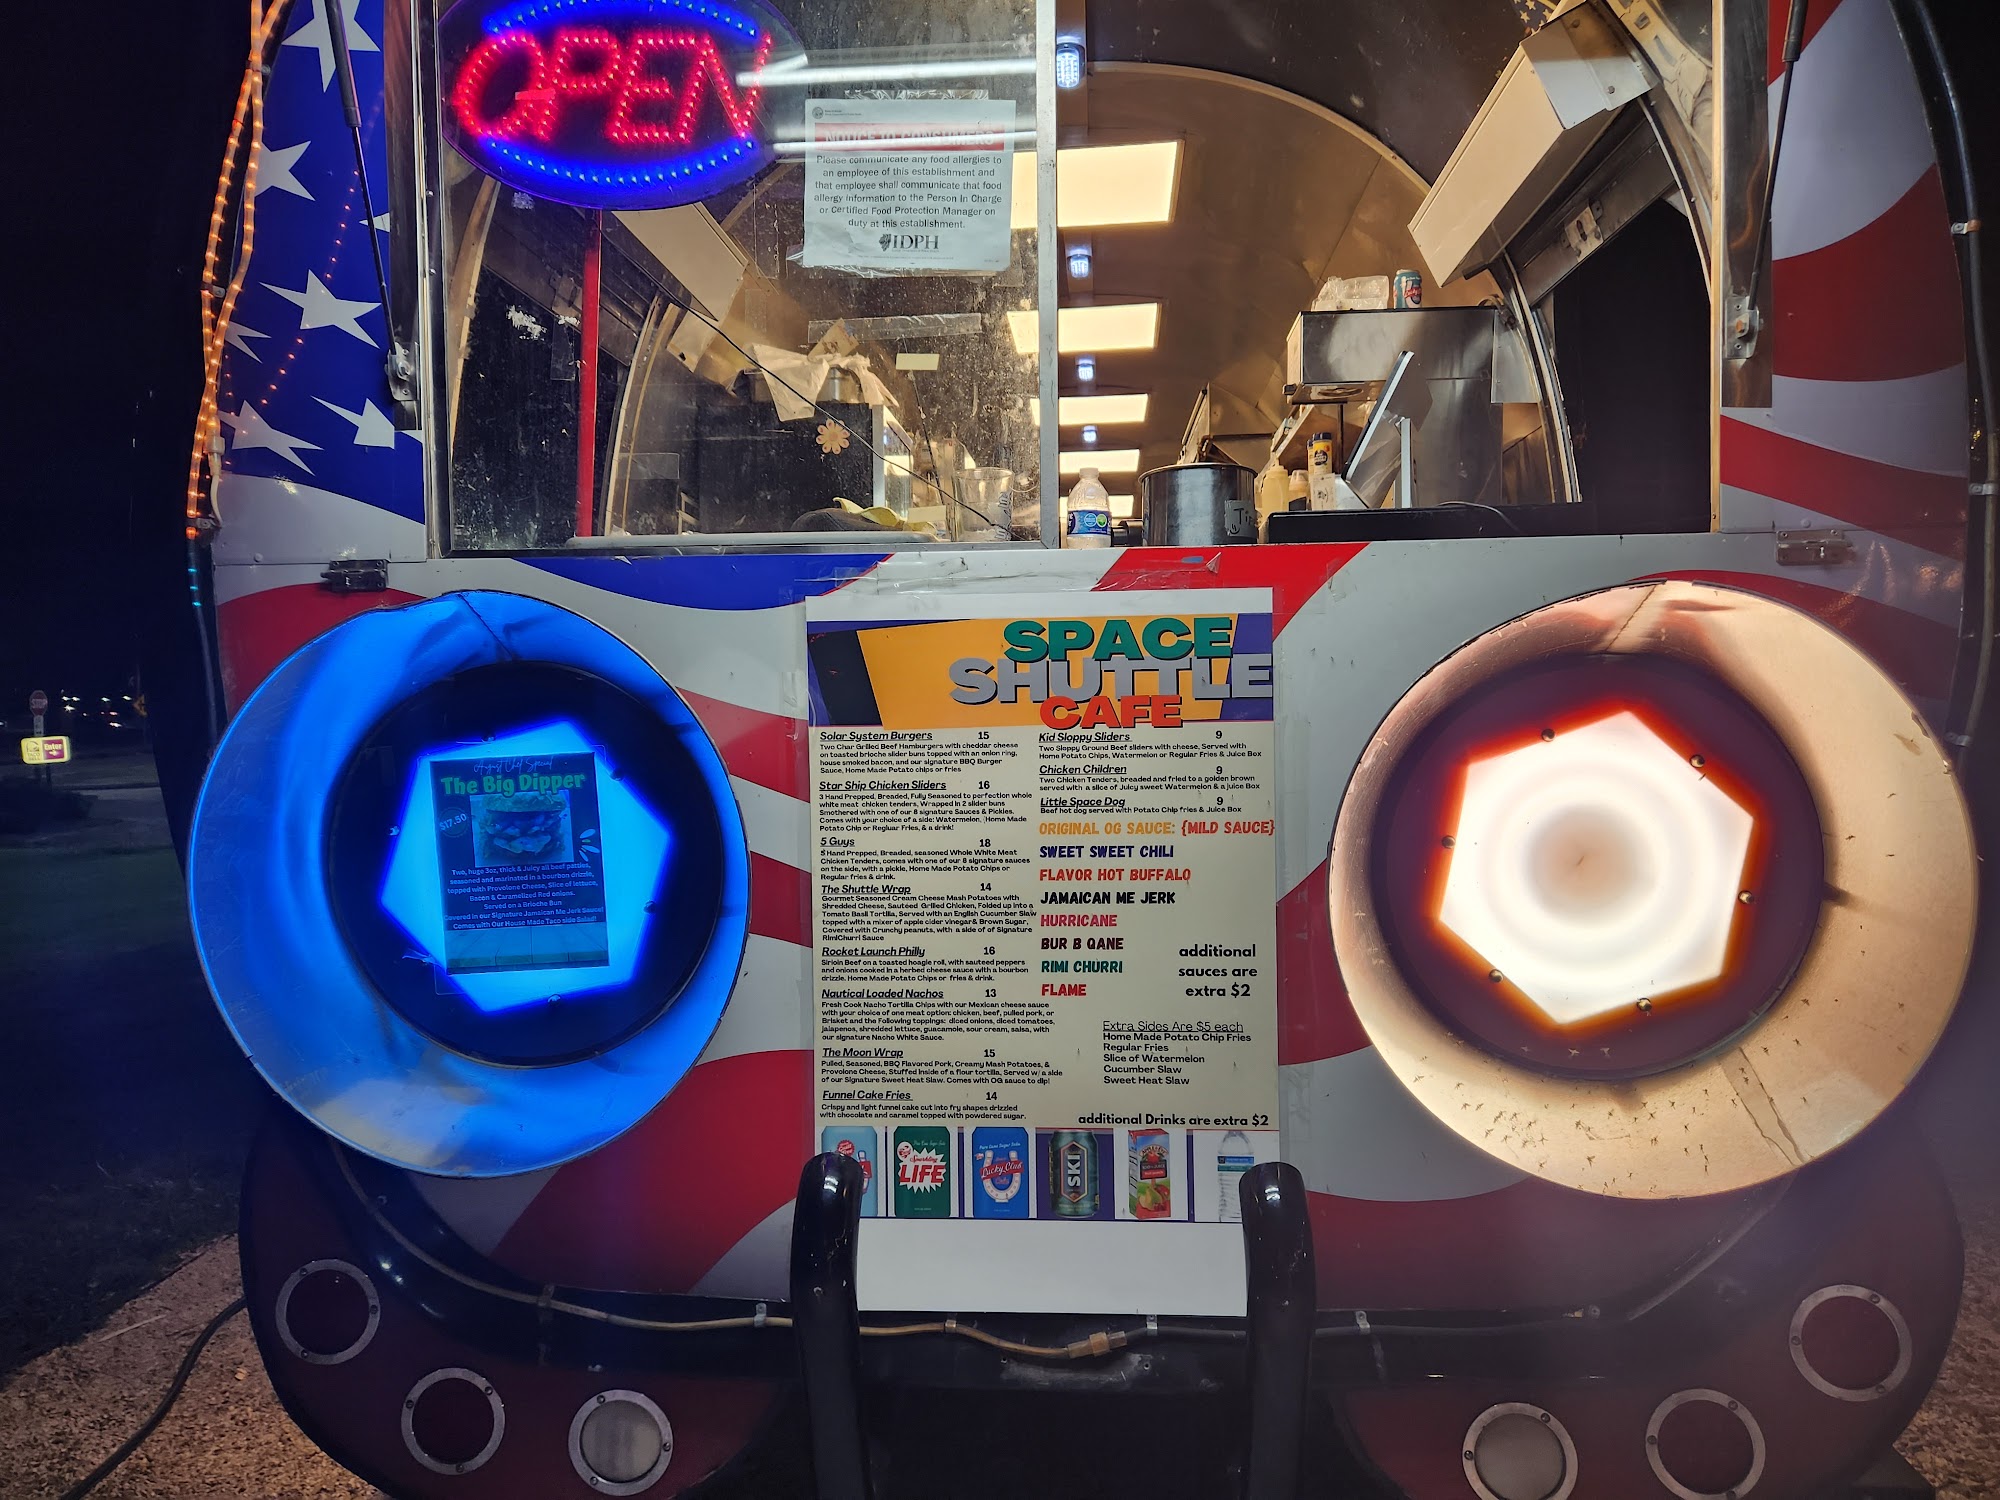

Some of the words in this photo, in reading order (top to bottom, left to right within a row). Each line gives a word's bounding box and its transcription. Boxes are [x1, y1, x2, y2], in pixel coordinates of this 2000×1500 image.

[455, 28, 774, 144] OPEN
[816, 155, 846, 164] Please
[912, 156, 927, 164] any
[953, 156, 990, 165] allergies
[837, 168, 878, 178] employee
[882, 168, 890, 176] of
[912, 168, 975, 176] establishment
[815, 181, 832, 189] that
[835, 182, 876, 191] employee
[901, 181, 960, 189] communicate
[963, 181, 980, 189] that
[814, 194, 843, 203] allergy
[927, 194, 956, 202] Person
[971, 195, 1002, 203] Charge
[832, 206, 868, 214] Certified
[872, 206, 891, 215] Food
[895, 207, 939, 215] Protection
[943, 207, 981, 217] Manager
[849, 219, 868, 228] duty
[900, 219, 965, 228] establishment.
[892, 235, 939, 250] IDPH
[1003, 615, 1234, 662] SPACE
[948, 653, 1273, 704] SHUTTLE
[32, 699, 47, 708] STOP
[1038, 695, 1183, 729] CAFE
[820, 732, 848, 740] Solar
[850, 732, 888, 742] System
[891, 731, 932, 741] Burgers
[978, 731, 990, 740] 15
[1039, 733, 1055, 742] Kid
[1057, 733, 1093, 744] Sloppy
[1095, 732, 1130, 742] Sliders
[1216, 730, 1222, 739] 9
[1039, 765, 1081, 774] Chicken
[1083, 764, 1126, 774] Children
[1216, 766, 1222, 775] 9
[440, 777, 478, 795] The
[483, 775, 515, 797] Big
[519, 772, 585, 794] Dipper
[819, 782, 843, 790] Star
[845, 781, 866, 792] Ship
[869, 780, 909, 789] Chicken
[912, 780, 946, 789] Sliders
[978, 781, 990, 790] 16
[1041, 797, 1067, 807] Little
[1070, 798, 1102, 808] Space
[1104, 798, 1125, 807] Dog
[1217, 796, 1223, 806] 9
[439, 813, 467, 831] $17.50
[1039, 822, 1099, 835] ORIGINAL
[1105, 822, 1121, 834] OG
[1127, 822, 1175, 834] SAUCE:
[1181, 819, 1218, 836] {MILD
[1224, 820, 1275, 836] SAUCE}
[821, 837, 827, 846] 5
[829, 837, 855, 847] Guys
[979, 839, 991, 848] 18
[1040, 845, 1084, 858] SWEET
[1090, 845, 1134, 858] SWEET
[1140, 845, 1174, 858] CHILI
[1039, 869, 1092, 881] FLAVOR
[1098, 869, 1124, 881] HOT
[1130, 869, 1191, 881] BUFFALO
[822, 885, 840, 894] The
[842, 885, 879, 894] Shuttle
[882, 885, 911, 895] Wrap
[980, 883, 991, 892] 14
[1041, 891, 1111, 905] JAMAICAN
[1116, 892, 1135, 904] ME
[1141, 891, 1175, 904] JERK
[1041, 914, 1117, 926] HURRICANE
[1041, 938, 1067, 950] BUR
[1073, 938, 1081, 949] B
[822, 947, 859, 956] Rocket
[861, 947, 897, 956] Launch
[899, 947, 925, 957] Philly
[983, 947, 995, 955] 16
[1179, 944, 1255, 957] additional
[1042, 961, 1068, 973] RIMI
[1074, 961, 1123, 973] CHURRI
[1179, 967, 1227, 977] sauces
[1232, 967, 1258, 977] are
[822, 989, 864, 999] Nautical
[867, 989, 903, 999] Loaded
[905, 989, 944, 999] Nachos
[985, 989, 996, 998] 13
[1042, 984, 1086, 996] FLAME
[1186, 985, 1225, 997] extra
[1231, 982, 1250, 997] $2
[1103, 1021, 1134, 1032] Extra
[1138, 1021, 1168, 1032] Sides
[1173, 1022, 1192, 1032] Are
[1197, 1021, 1211, 1032] $5
[1215, 1021, 1243, 1032] each
[1103, 1033, 1131, 1041] Home
[1134, 1033, 1161, 1041] Made
[1164, 1033, 1199, 1042] Potato
[1202, 1033, 1224, 1043] Chip
[1227, 1034, 1251, 1042] Fries
[823, 1048, 841, 1057] The
[843, 1048, 872, 1057] Moon
[874, 1048, 903, 1058] Wrap
[984, 1049, 995, 1057] 15
[1104, 1044, 1142, 1053] Regular
[1145, 1044, 1169, 1052] Fries
[1104, 1054, 1126, 1062] Slice
[1129, 1054, 1139, 1062] of
[1142, 1054, 1205, 1063] Watermelon
[1104, 1065, 1155, 1074] Cucumber
[1158, 1065, 1182, 1074] Slaw
[1104, 1076, 1136, 1084] Sweet
[1139, 1076, 1163, 1084] Heat
[1166, 1076, 1190, 1084] Slaw
[823, 1091, 856, 1100] Funnel
[858, 1090, 884, 1100] Cake
[886, 1090, 911, 1099] Fries
[986, 1092, 997, 1101] 14
[1078, 1113, 1142, 1125] additional
[1146, 1114, 1185, 1125] Drinks
[1189, 1117, 1208, 1125] are
[1214, 1116, 1248, 1126] extra
[1252, 1114, 1269, 1127] $2
[900, 1165, 946, 1183] LIFE
[981, 1165, 1006, 1178] Lucky
[1005, 1161, 1022, 1172] Club
[1068, 1154, 1081, 1187] SKI
